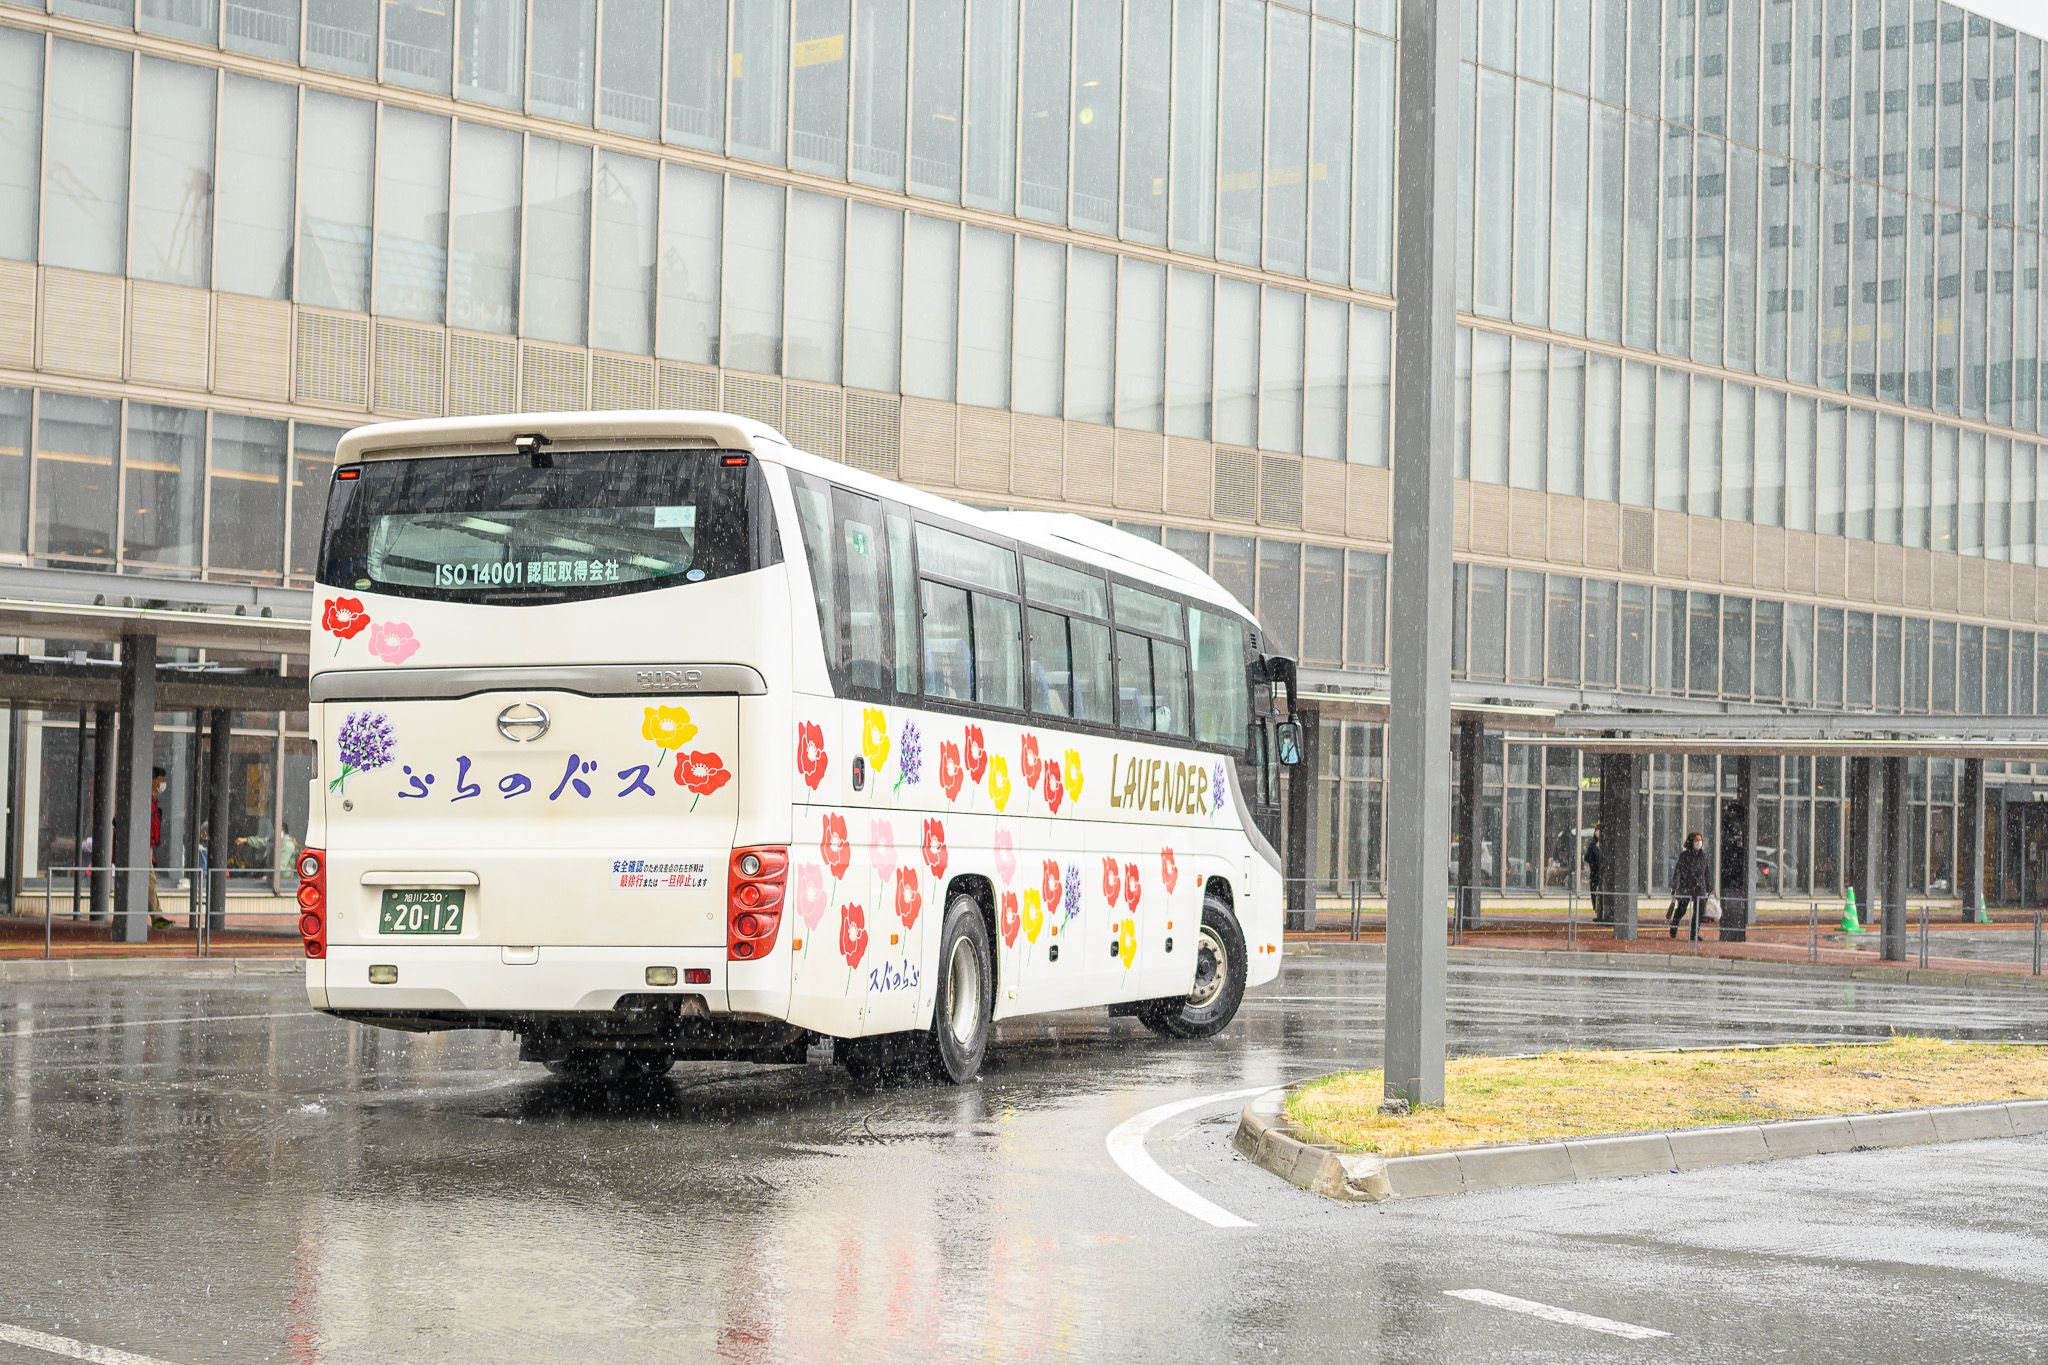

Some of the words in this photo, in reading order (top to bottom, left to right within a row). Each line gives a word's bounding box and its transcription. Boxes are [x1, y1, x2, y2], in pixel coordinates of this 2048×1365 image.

[435, 563, 468, 586] ISO
[471, 561, 522, 585] 14001
[527, 559, 620, 583] 認証取得会社
[637, 669, 703, 682] HINO
[398, 753, 656, 803] ふらのバス
[1110, 753, 1208, 816] LAVENDER
[404, 893, 443, 903] 旭川230
[393, 904, 460, 931] 20-12
